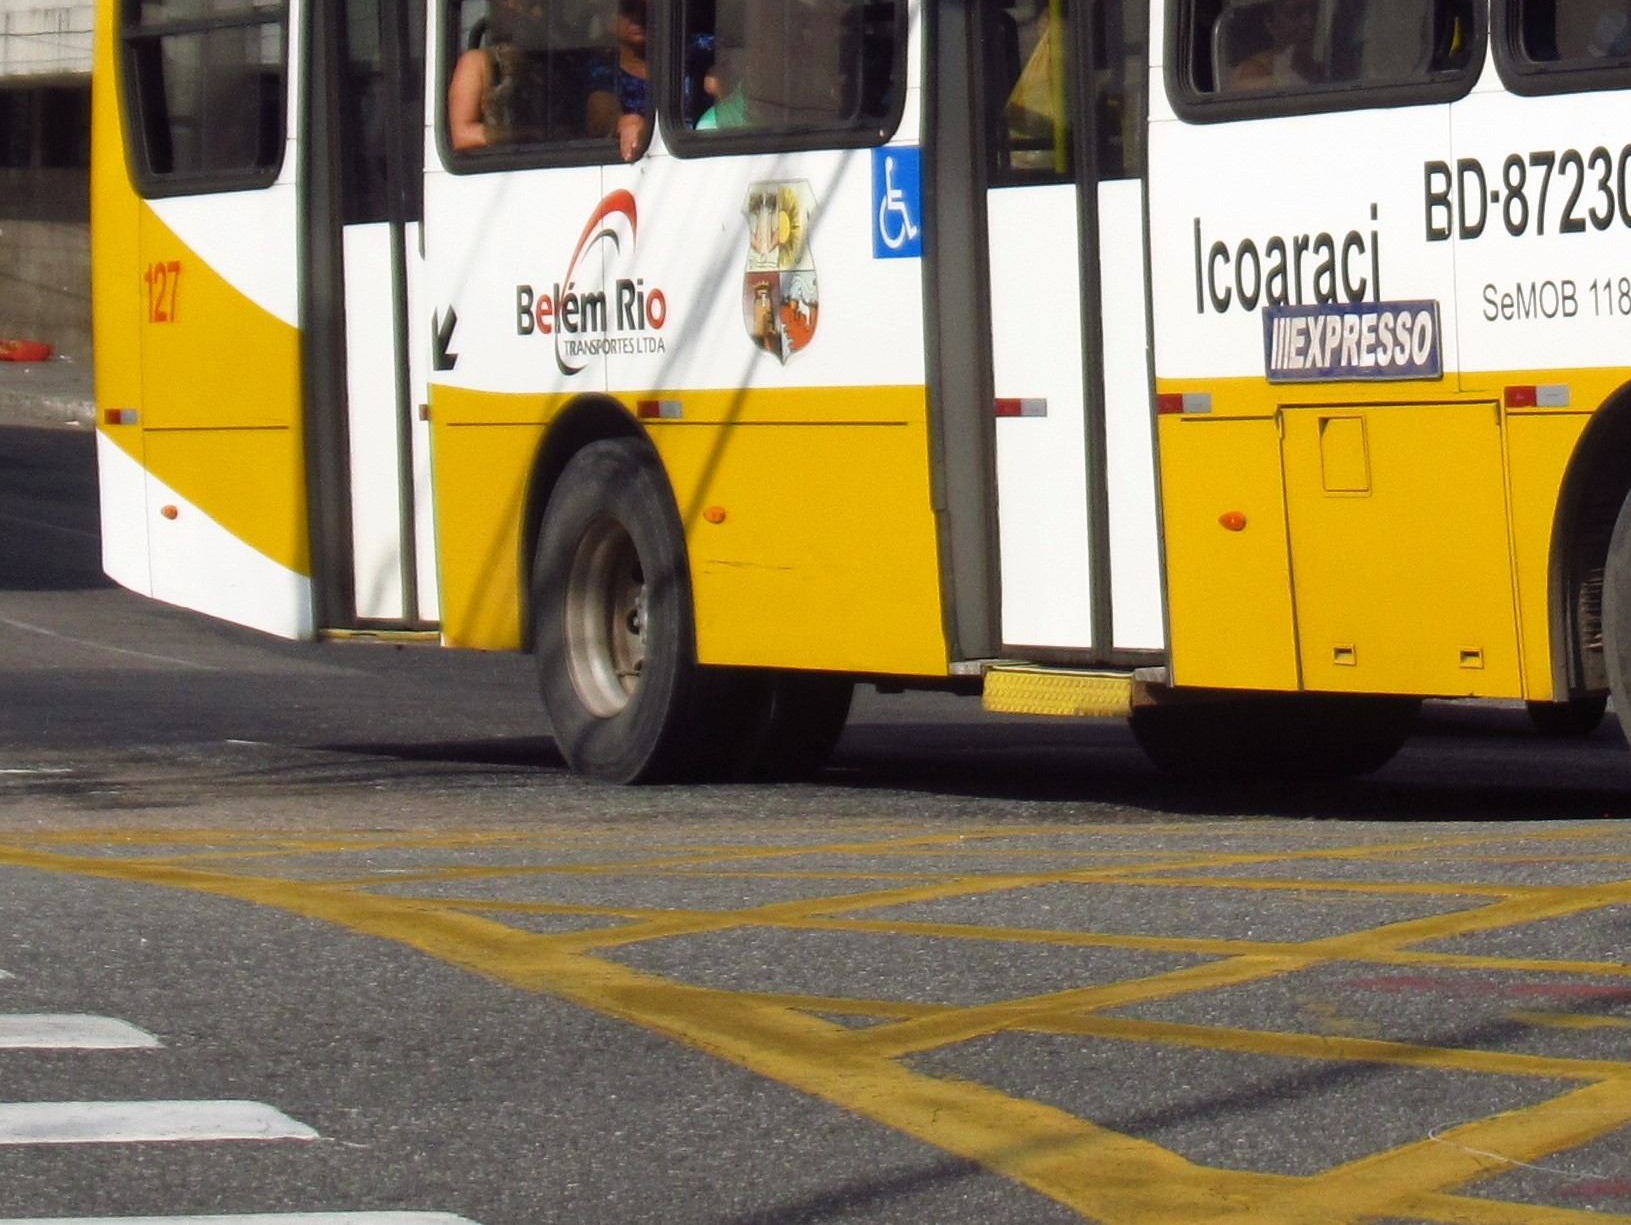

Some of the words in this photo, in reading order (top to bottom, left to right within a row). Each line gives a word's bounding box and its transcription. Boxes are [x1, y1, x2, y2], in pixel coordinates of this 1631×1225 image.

[1193, 203, 1381, 314] Icoaraci
[144, 261, 182, 323] 127
[516, 282, 607, 335] Belém
[616, 278, 667, 331] Rio
[1483, 280, 1578, 322] SeMOB
[563, 337, 634, 356] TRANSPORTES
[637, 336, 666, 354] LTDA
